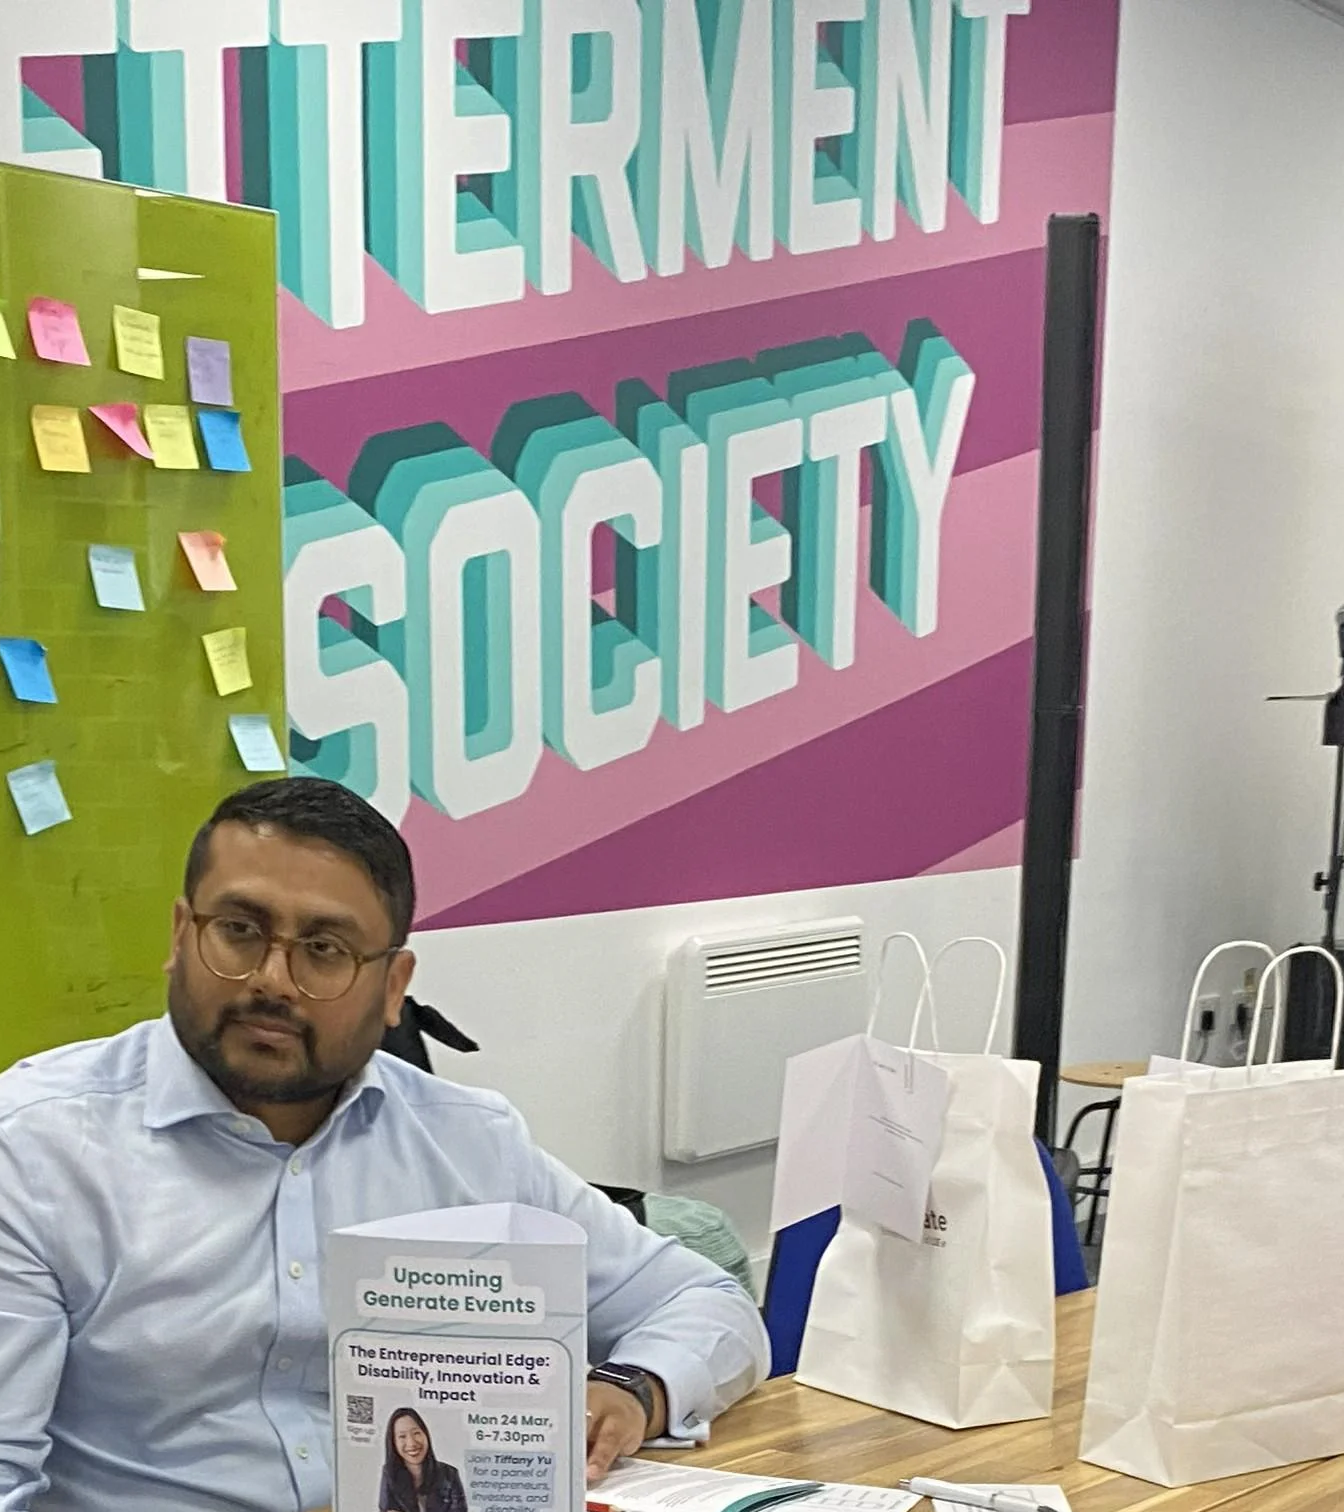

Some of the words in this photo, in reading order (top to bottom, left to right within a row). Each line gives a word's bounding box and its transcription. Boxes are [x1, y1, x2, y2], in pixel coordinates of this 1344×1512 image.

[281, 348, 977, 831] SOCIETY
[394, 1267, 502, 1293] Upcoming
[363, 1290, 459, 1311] Generate
[465, 1296, 535, 1314] Events
[349, 1345, 376, 1359] The
[380, 1348, 501, 1366] Entrepreneurial
[506, 1354, 550, 1370] Edge:
[358, 1364, 434, 1384] Disability,
[437, 1370, 524, 1385] Innovation
[528, 1373, 540, 1385] &
[419, 1388, 476, 1404] Impact
[468, 1414, 498, 1426] Mon
[501, 1414, 518, 1426] 24
[521, 1414, 553, 1428] Mar,
[468, 1454, 491, 1464] Join
[494, 1455, 533, 1467] Tiffany
[537, 1455, 552, 1465] Yu
[473, 1466, 489, 1477] for
[491, 1469, 498, 1477] a
[501, 1467, 533, 1481] panel
[535, 1467, 548, 1477] of
[526, 1494, 549, 1503] and
